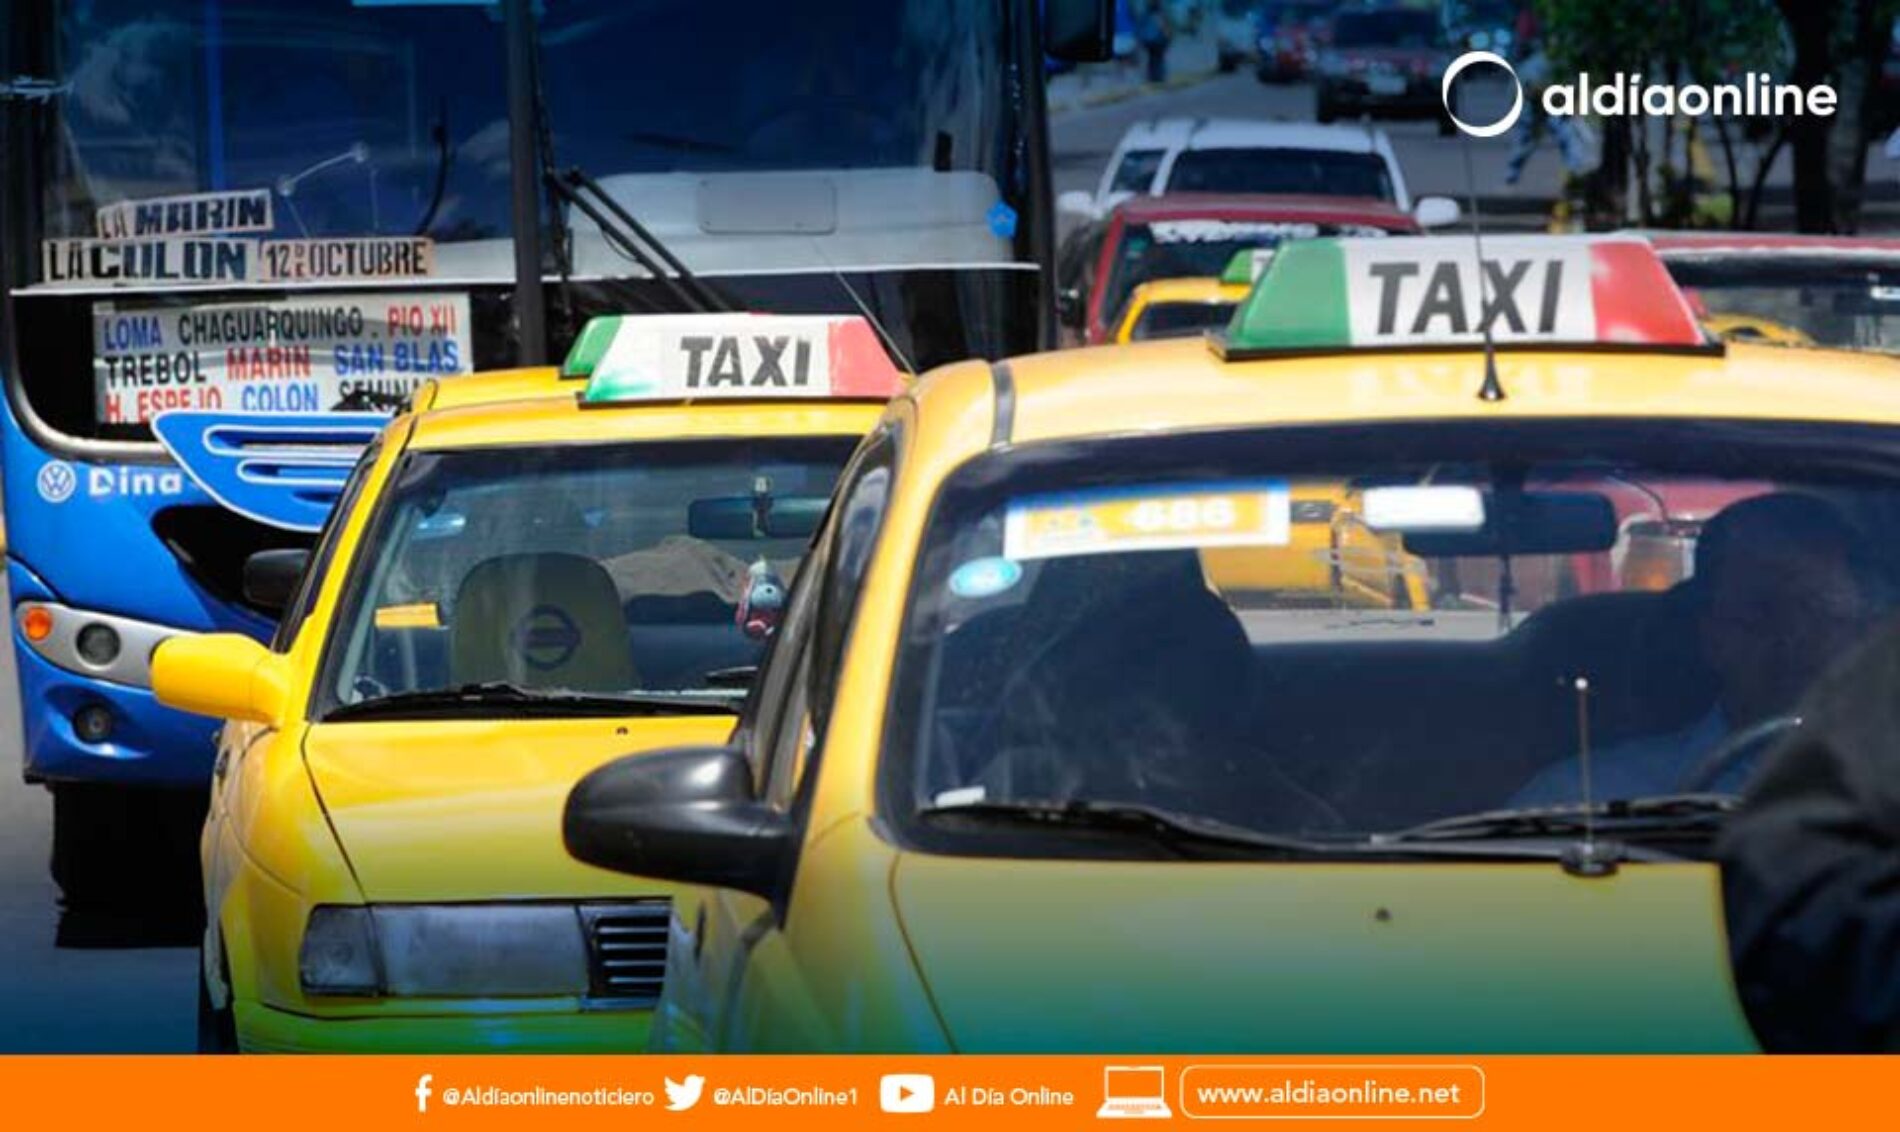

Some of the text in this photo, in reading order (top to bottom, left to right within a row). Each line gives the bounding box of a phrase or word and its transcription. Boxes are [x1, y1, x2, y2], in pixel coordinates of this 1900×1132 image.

[136, 196, 266, 236] MARIN
[50, 242, 246, 280] LA COLON
[266, 243, 290, 278] 12
[309, 241, 427, 277] OCTUBRE
[1369, 260, 1564, 334] TAXI
[104, 303, 457, 350] LOMA CHAGUARQUINGO PIO XII
[103, 341, 458, 387] TREBOL MARIN SAN BLAS
[680, 336, 811, 387] TAXI
[242, 385, 318, 411] COLON
[89, 466, 182, 496] Dina
